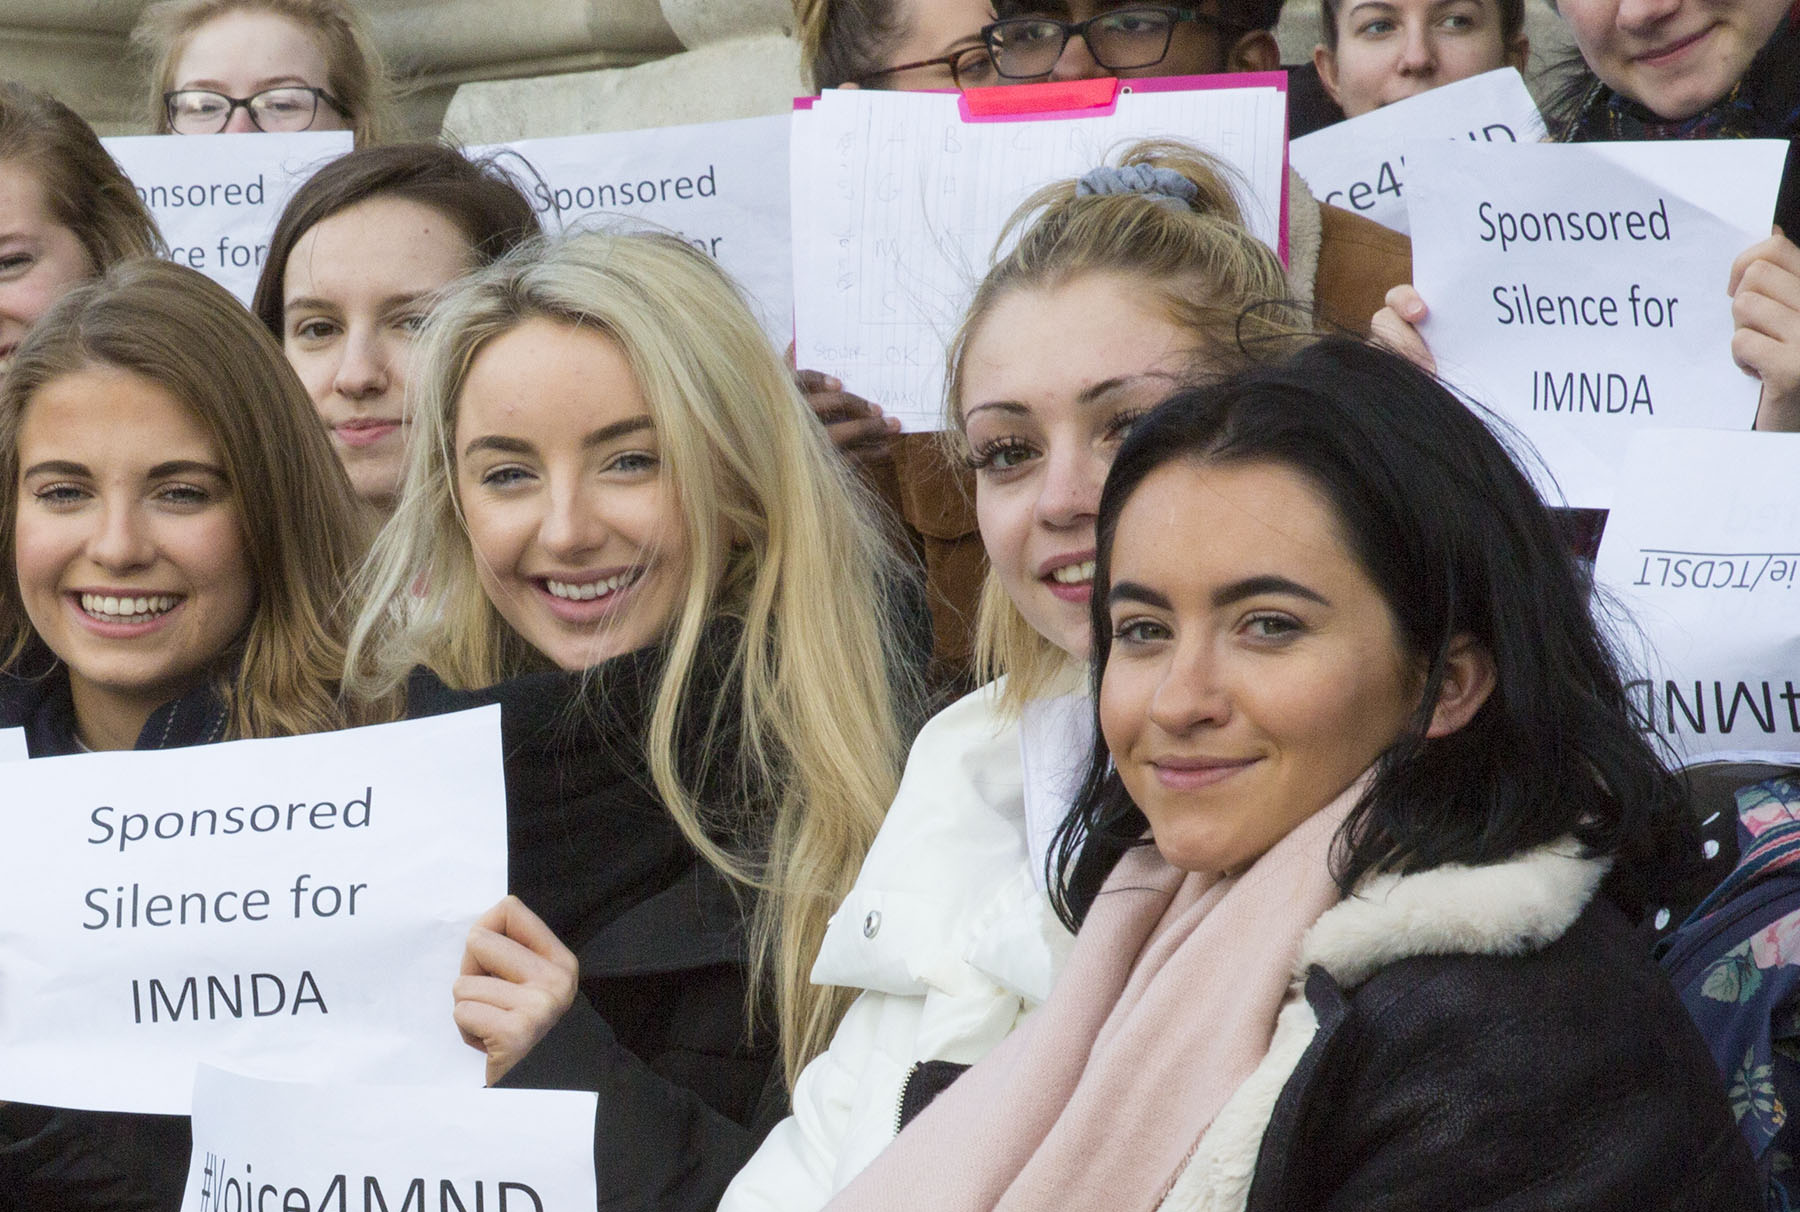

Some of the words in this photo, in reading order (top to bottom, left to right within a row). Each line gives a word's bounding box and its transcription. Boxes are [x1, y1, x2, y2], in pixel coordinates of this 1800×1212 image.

[136, 173, 265, 208] onsored
[533, 164, 717, 214] Sponsored
[1478, 198, 1671, 251] Sponsored
[216, 236, 269, 268] for
[1492, 284, 1619, 327] Silence
[1628, 284, 1679, 329] for
[1531, 370, 1654, 416] IMNDA
[87, 786, 373, 851] Sponsored
[82, 883, 272, 931] Silence
[290, 873, 368, 919] for
[132, 970, 329, 1025] IMNDA
